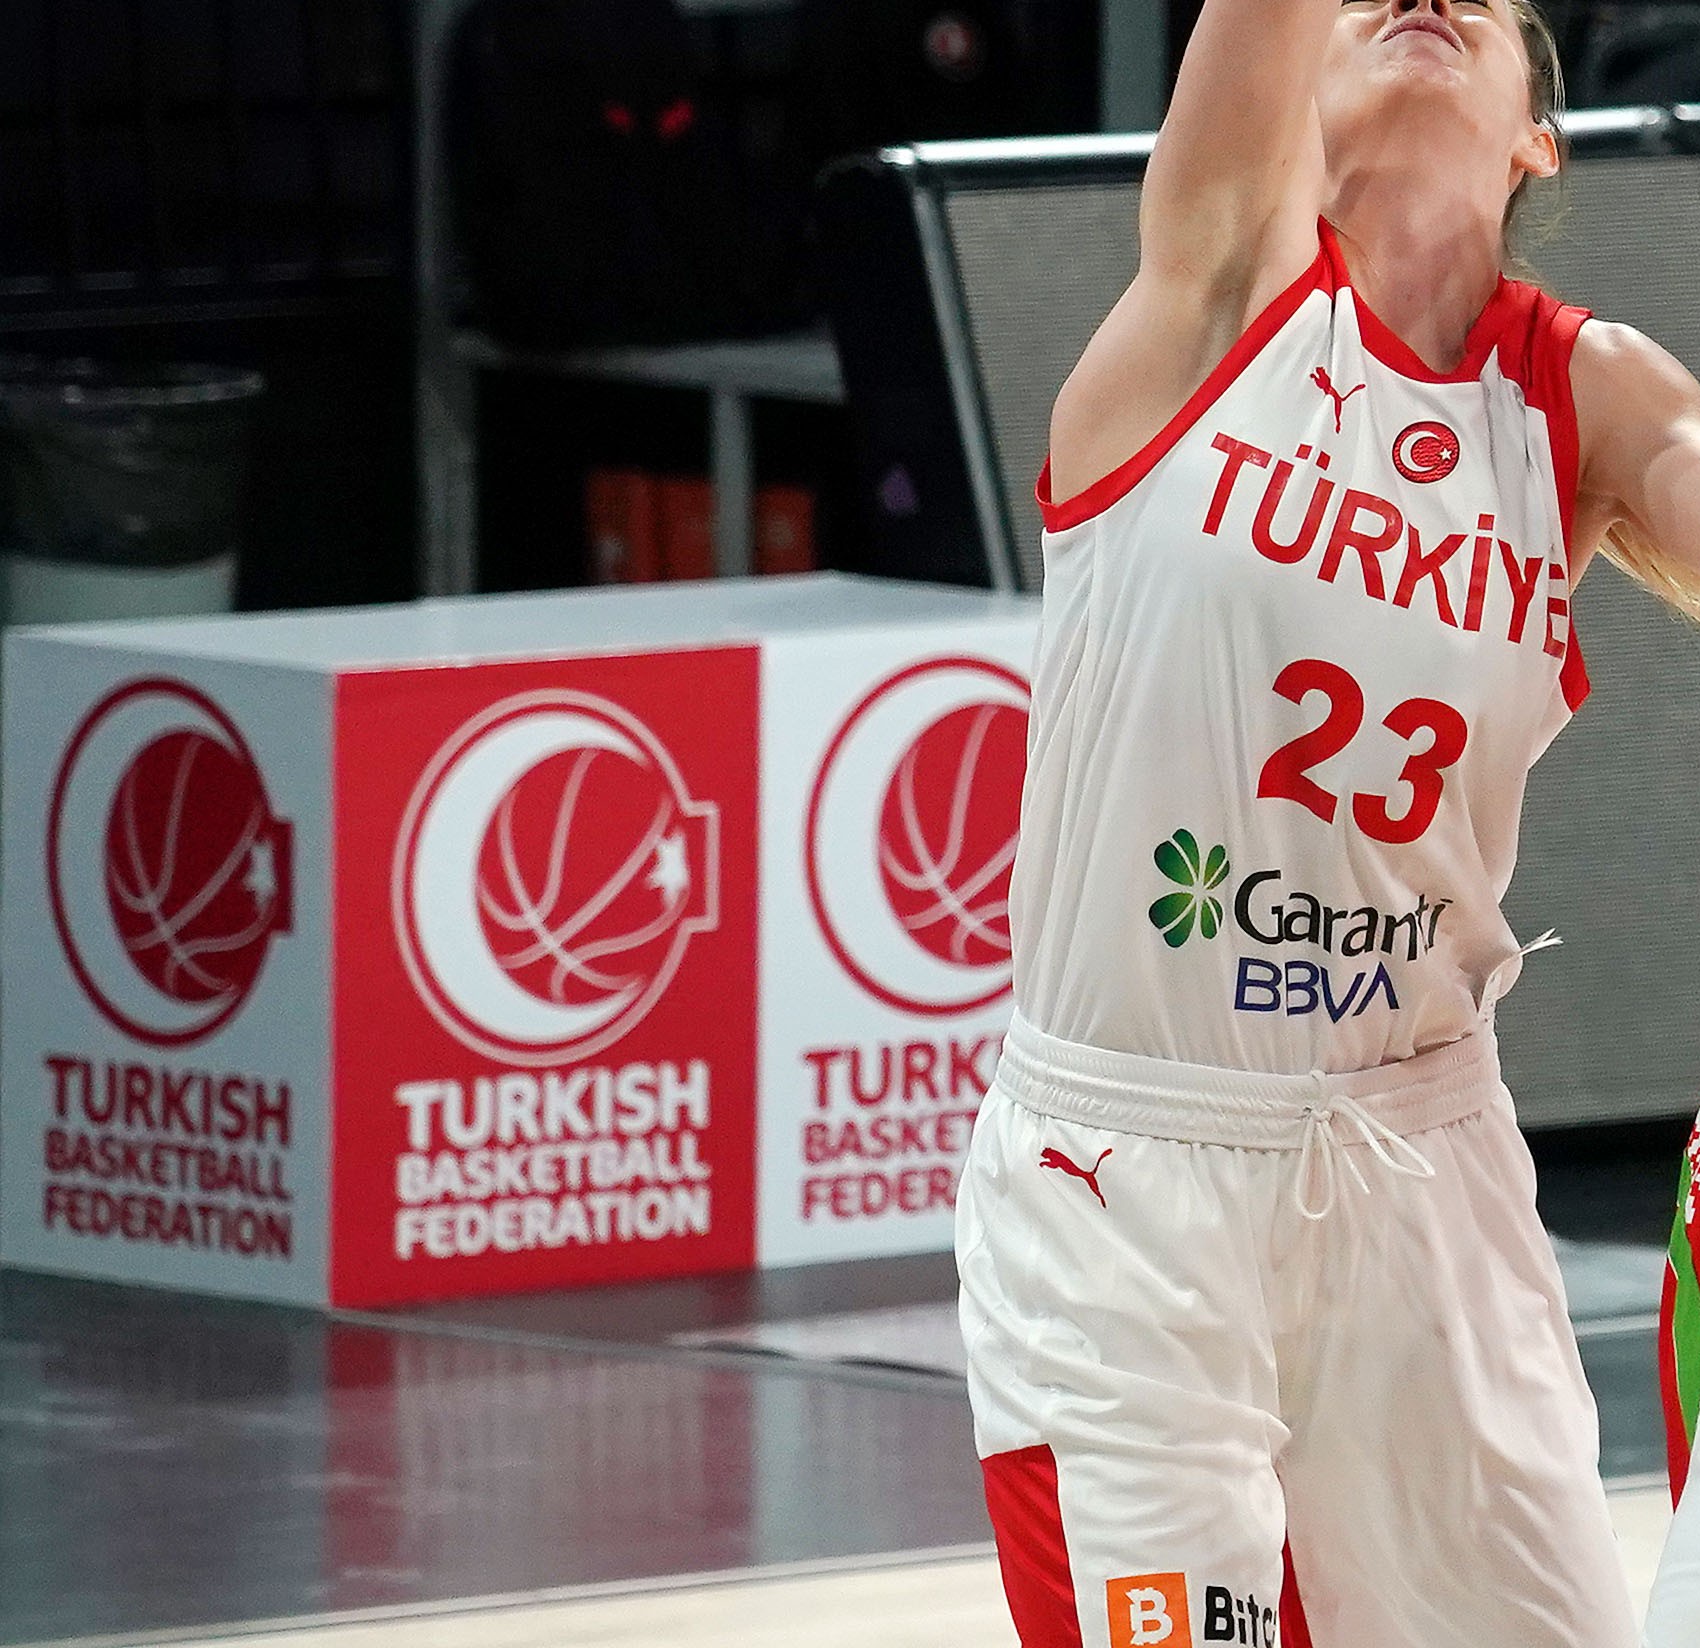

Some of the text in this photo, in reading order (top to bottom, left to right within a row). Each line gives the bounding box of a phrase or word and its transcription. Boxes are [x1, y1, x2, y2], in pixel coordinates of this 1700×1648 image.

[1201, 432, 1568, 659] TÜRKİYE
[1257, 658, 1468, 844] 23
[1234, 870, 1453, 962] Garanti
[1234, 957, 1400, 1024] BBVA
[44, 1053, 292, 1148] TURKISH
[395, 1058, 711, 1150] TURKISH
[803, 1032, 1008, 1110] TURK
[44, 1126, 293, 1202] BASKETBALL
[395, 1132, 712, 1205] BASKETBALL
[43, 1183, 293, 1260] FEDERATION
[395, 1186, 711, 1261] FEDERATION
